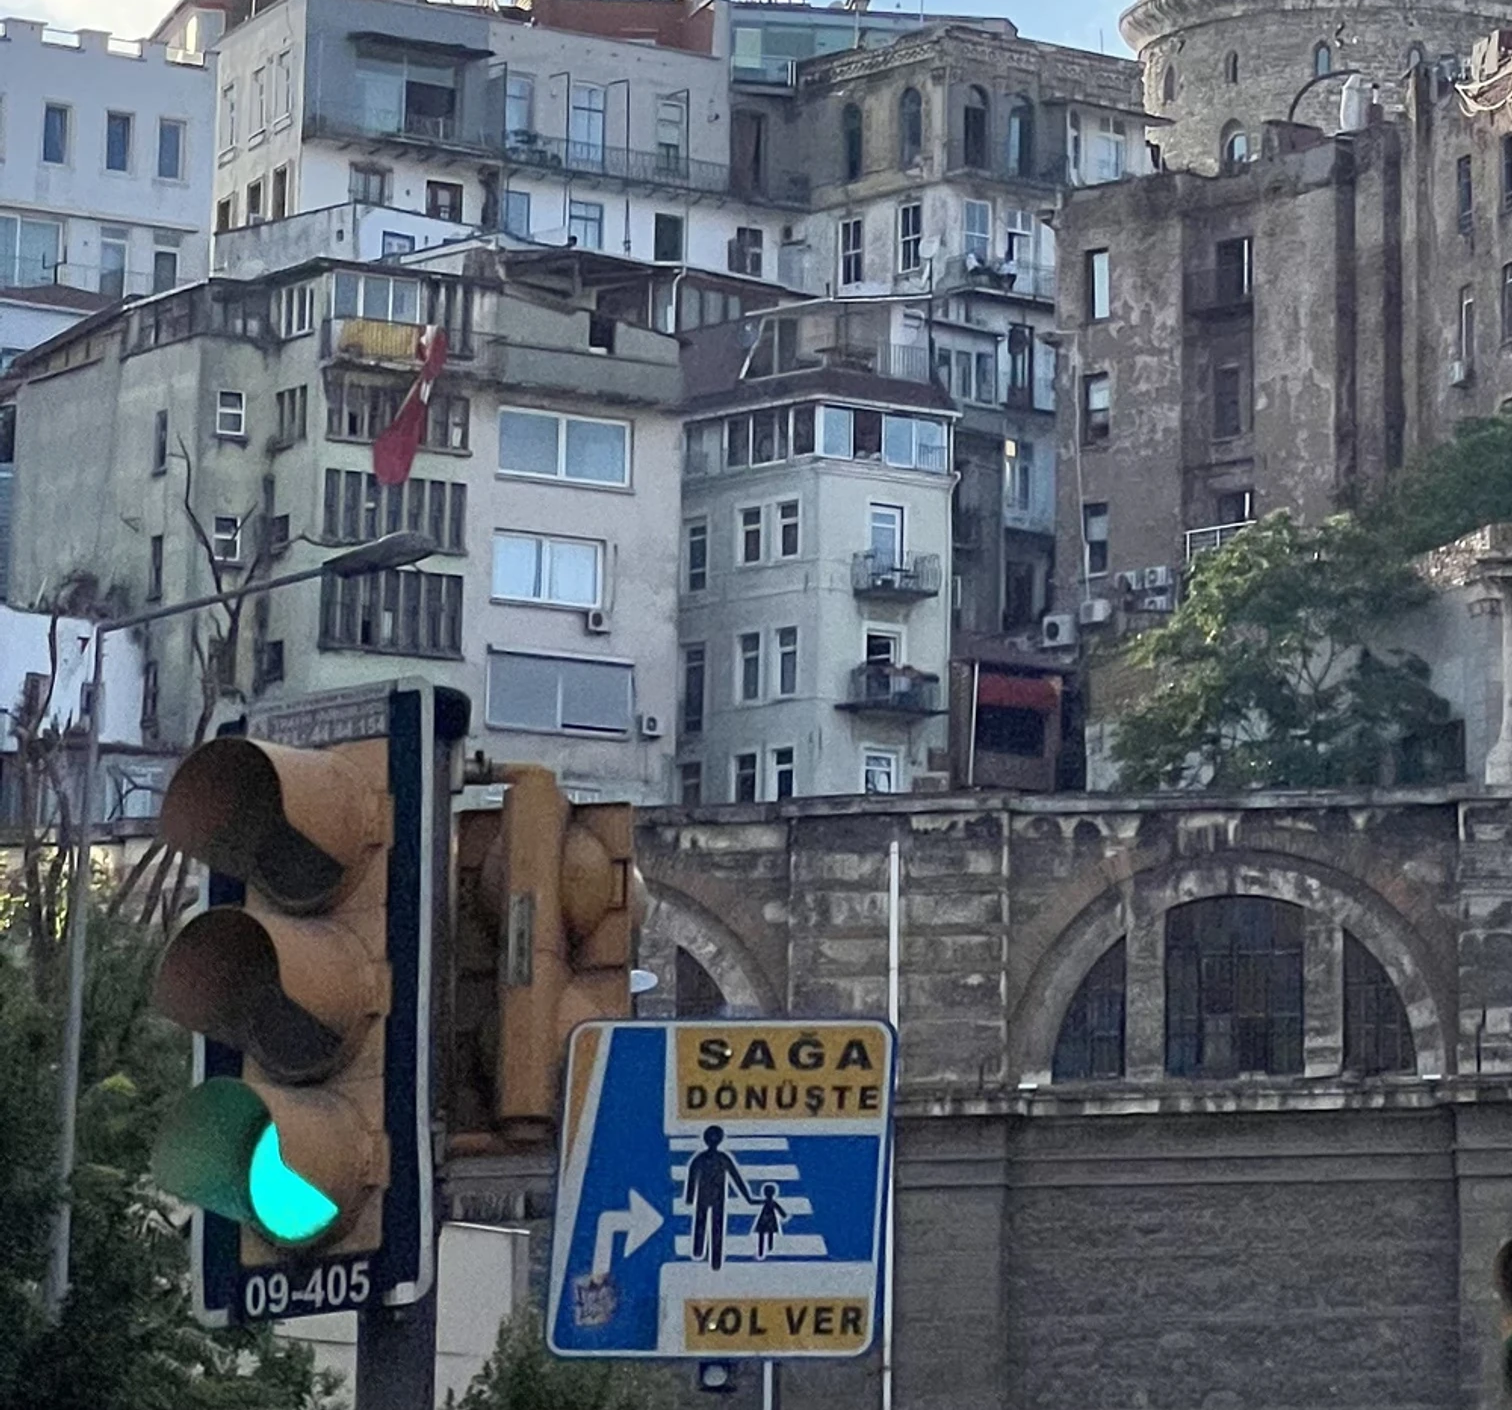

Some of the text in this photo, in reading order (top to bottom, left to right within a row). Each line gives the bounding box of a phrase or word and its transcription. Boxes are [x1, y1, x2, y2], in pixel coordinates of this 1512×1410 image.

[697, 1030, 873, 1071] SAĞA
[686, 1079, 880, 1118] DÖNÜŞTE
[245, 1260, 371, 1317] 09-405
[693, 1305, 864, 1336] YOL VER
